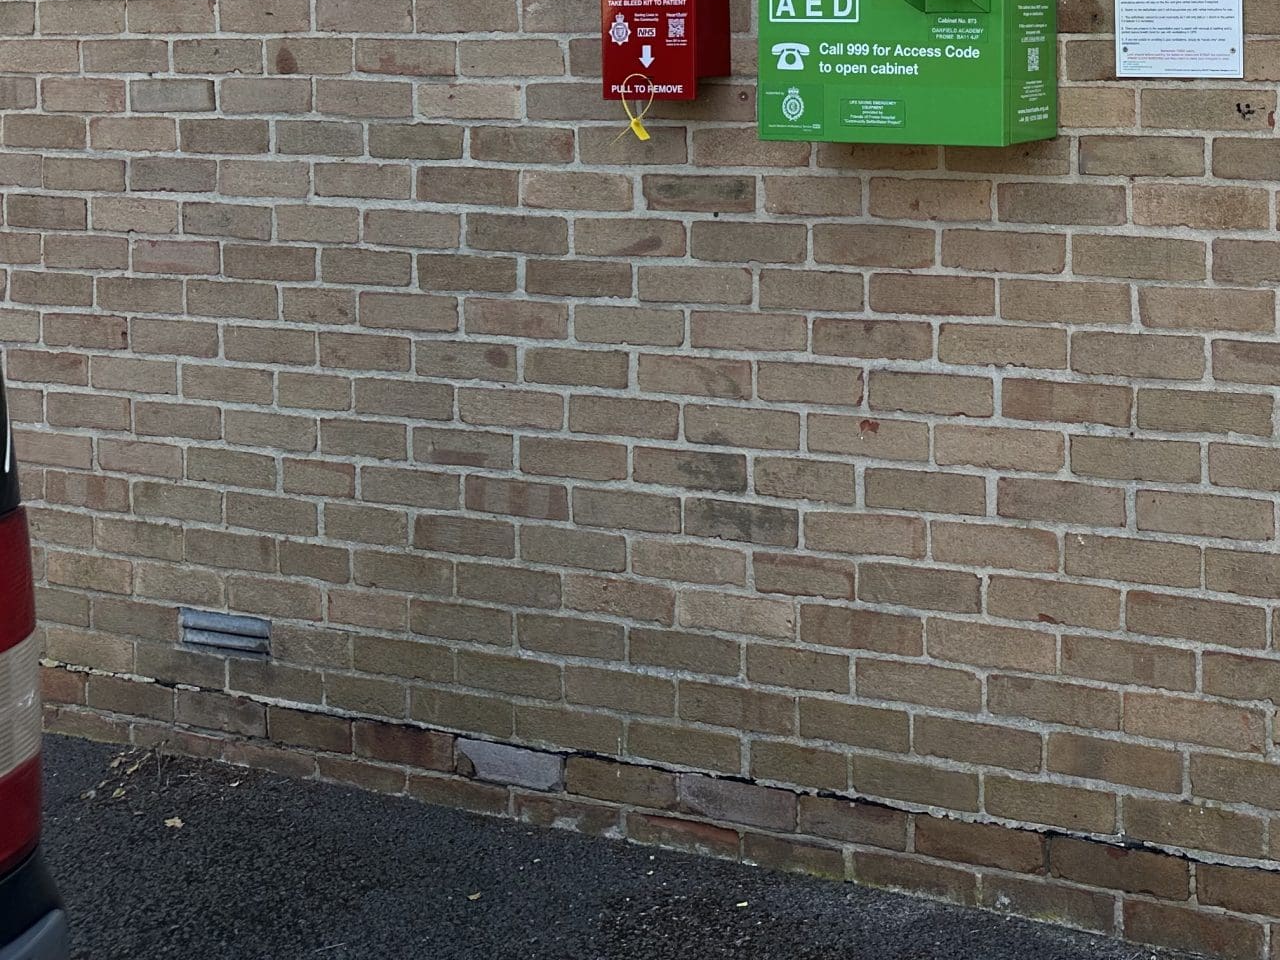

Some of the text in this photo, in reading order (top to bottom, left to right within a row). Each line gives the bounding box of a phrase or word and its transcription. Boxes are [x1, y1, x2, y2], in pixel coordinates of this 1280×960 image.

[819, 43, 980, 58] Call 999 for Access Code
[819, 61, 918, 77] to open cabinet
[611, 85, 683, 93] PULL TO REMOVE
